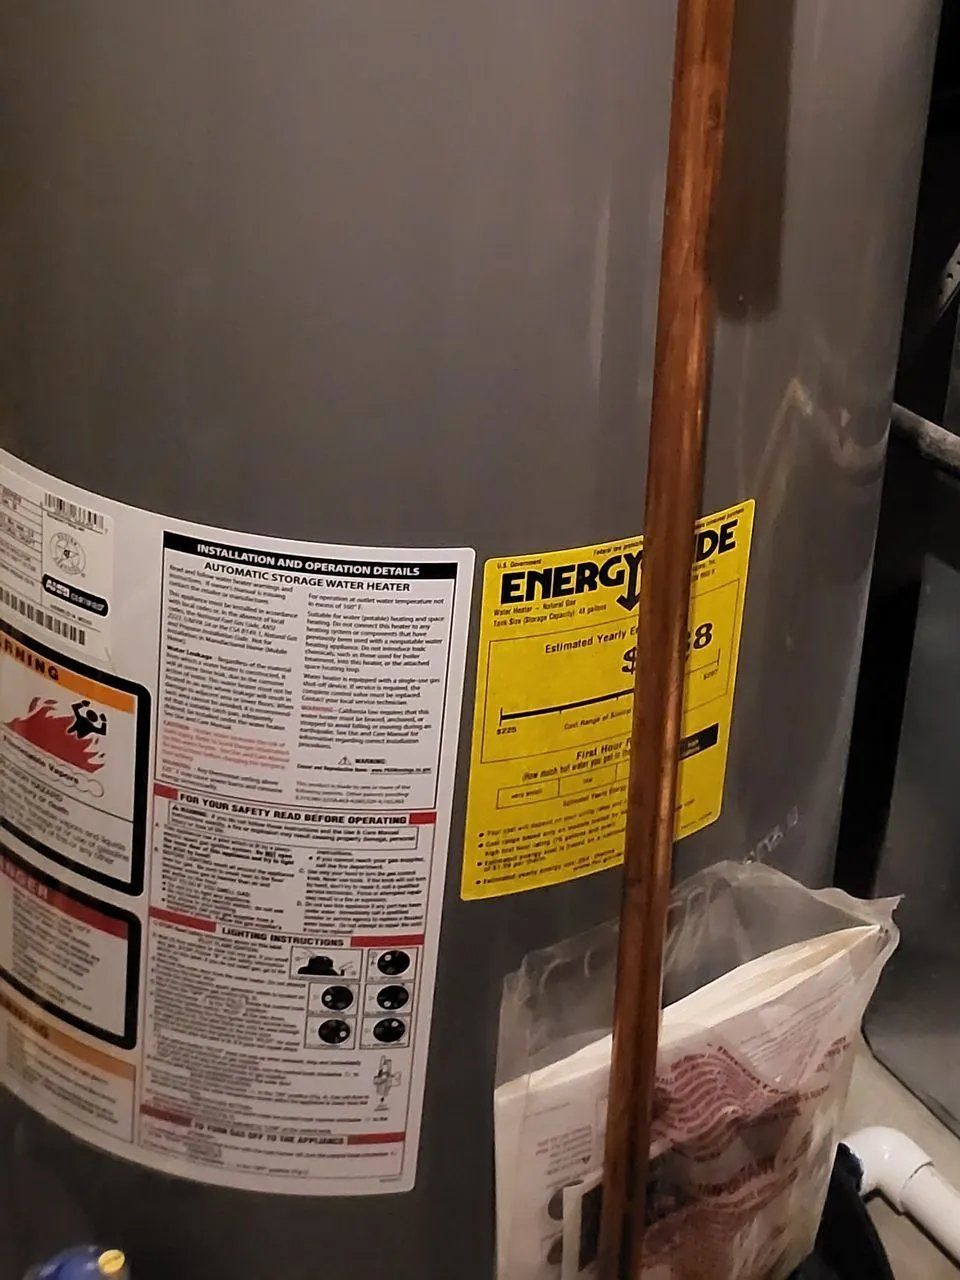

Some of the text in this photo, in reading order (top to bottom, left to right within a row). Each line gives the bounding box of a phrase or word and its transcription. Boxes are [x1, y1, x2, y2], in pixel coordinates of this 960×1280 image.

[197, 544, 420, 575] INSTALLATION AND OPERATION DETAILS
[205, 562, 410, 591] AUTOMATIC STORAGE WATER HEATER
[494, 608, 511, 617] Water
[513, 605, 533, 614] Heater
[542, 600, 564, 611] Natural
[565, 598, 576, 607] Gas
[494, 618, 507, 627] Tank
[509, 616, 521, 626] Size
[545, 636, 593, 654] Estimated
[597, 630, 627, 644] Yearly
[576, 741, 623, 760] First Hour
[180, 793, 407, 825] FOR YOUR SAFETY READ BEFORE OPERATING
[222, 927, 344, 946] LIGHTING INSTRUCTIONS
